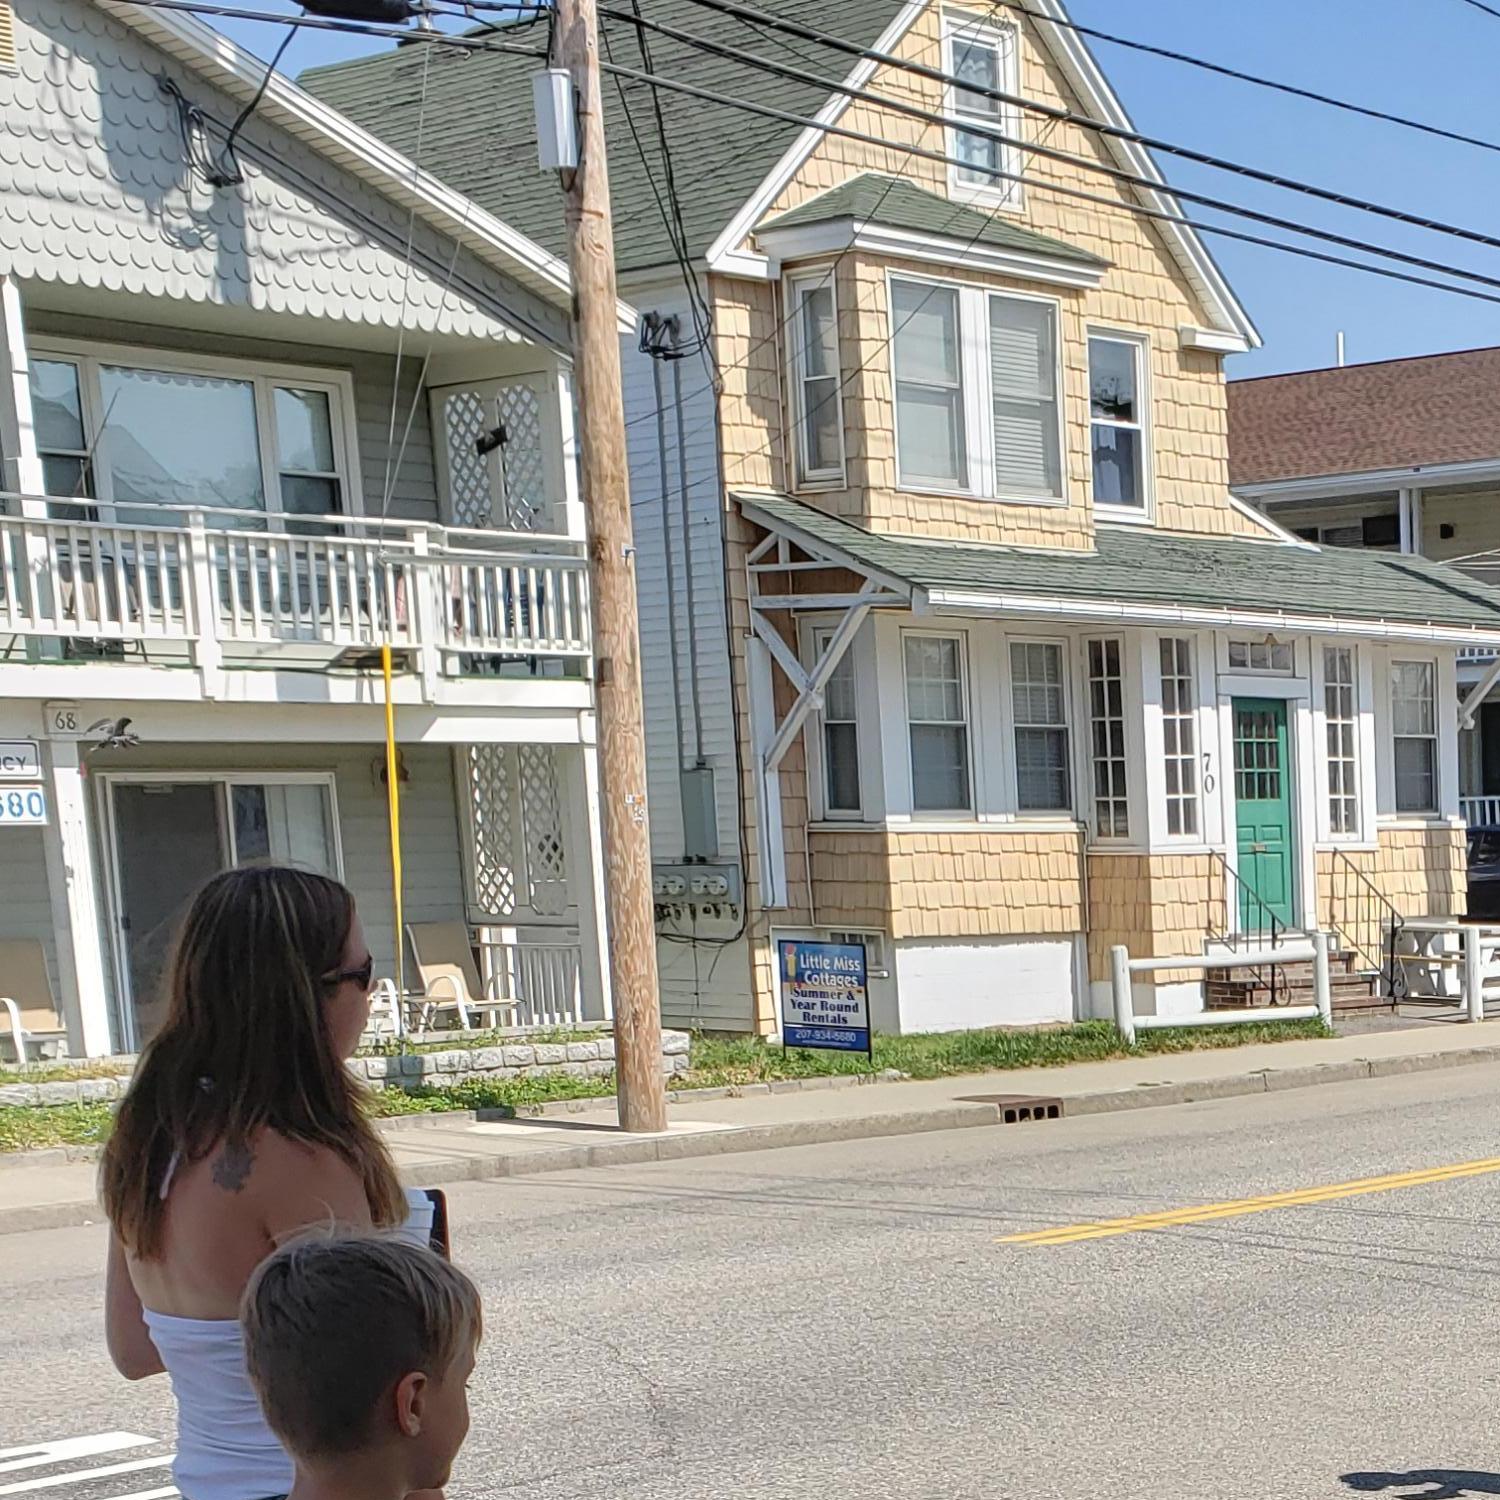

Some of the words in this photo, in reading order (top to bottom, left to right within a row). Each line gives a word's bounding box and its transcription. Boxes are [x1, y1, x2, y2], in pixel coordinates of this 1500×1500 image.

[55, 711, 76, 730] 68
[0, 756, 26, 771] CY
[800, 954, 830, 970] Little
[833, 956, 860, 971] Miss
[804, 970, 858, 989] Cottages
[794, 987, 843, 1000] Summer
[846, 990, 856, 1001] &
[790, 999, 817, 1011] Year
[820, 1001, 859, 1013] Round
[803, 1011, 848, 1024] Rentals
